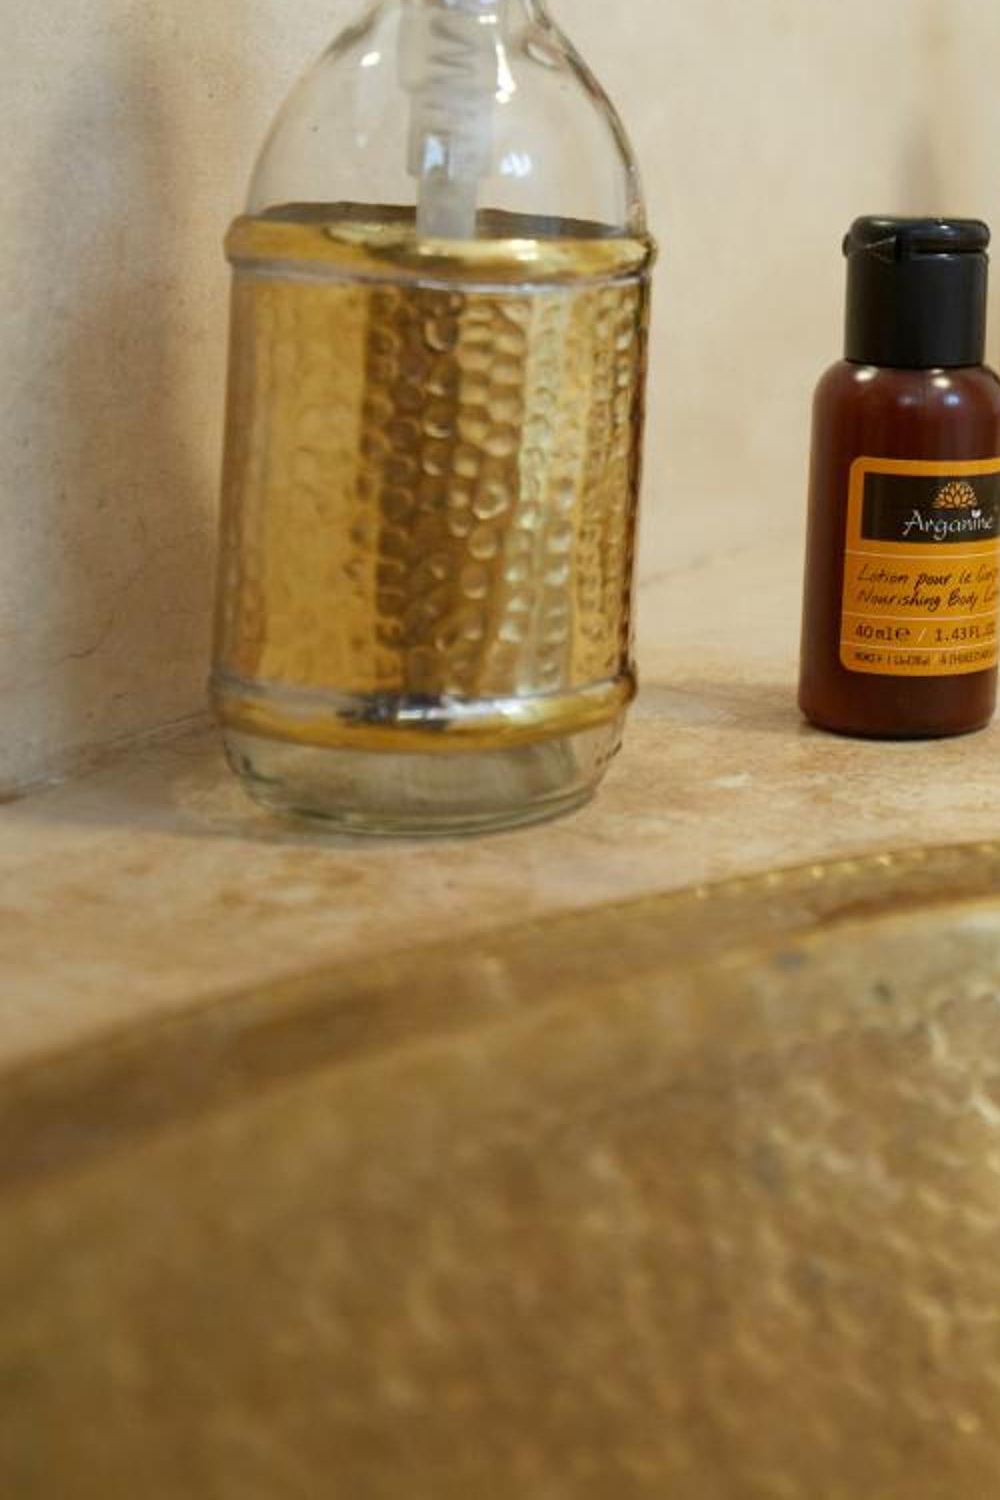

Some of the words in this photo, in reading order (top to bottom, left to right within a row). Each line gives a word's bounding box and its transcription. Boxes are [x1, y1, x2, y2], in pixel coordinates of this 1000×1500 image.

[902, 509, 993, 541] Arganine
[857, 563, 909, 584] Lotion
[913, 572, 952, 596] pour
[859, 586, 941, 612] Nourishing
[948, 587, 978, 612] Body
